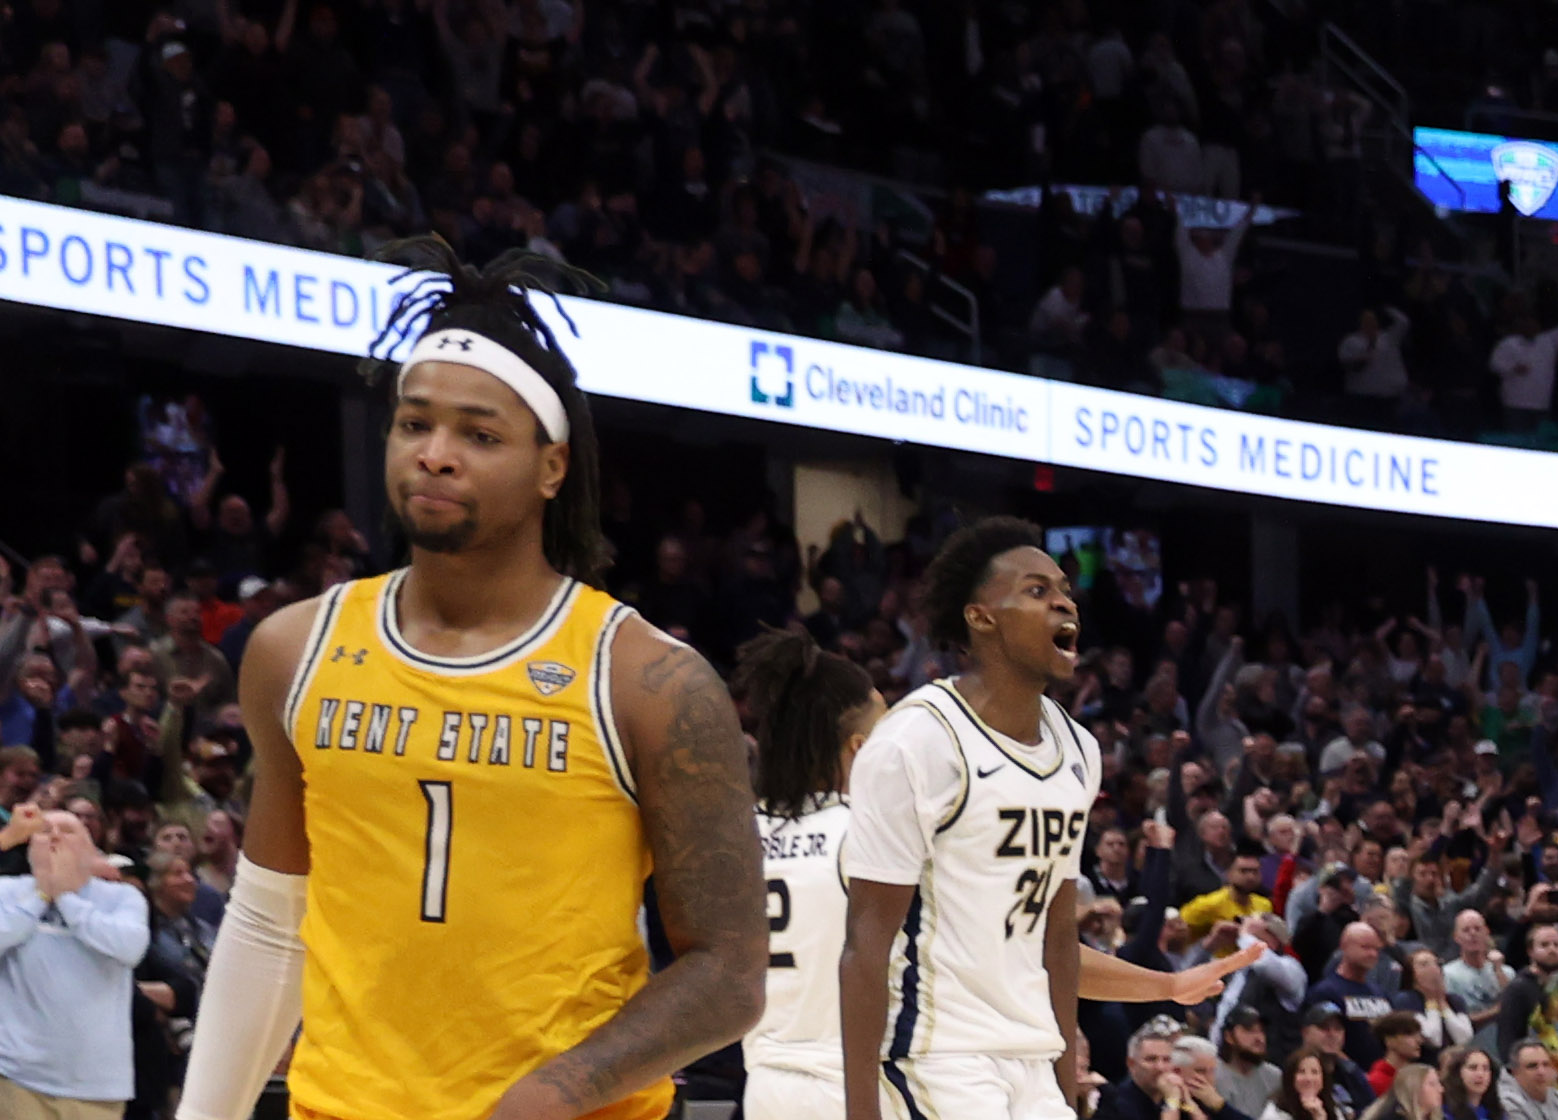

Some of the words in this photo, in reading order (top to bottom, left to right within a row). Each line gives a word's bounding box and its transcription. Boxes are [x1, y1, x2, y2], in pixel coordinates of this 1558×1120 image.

[243, 263, 411, 338] MEDI
[805, 364, 945, 420] Cleveland
[954, 388, 1029, 433] Clinic
[1074, 407, 1219, 468] SPORTS
[1240, 433, 1440, 496] MEDICINE
[314, 698, 419, 757] KENT
[437, 710, 570, 773] STATE
[416, 780, 453, 924] 1
[996, 806, 1085, 858] ZIPS
